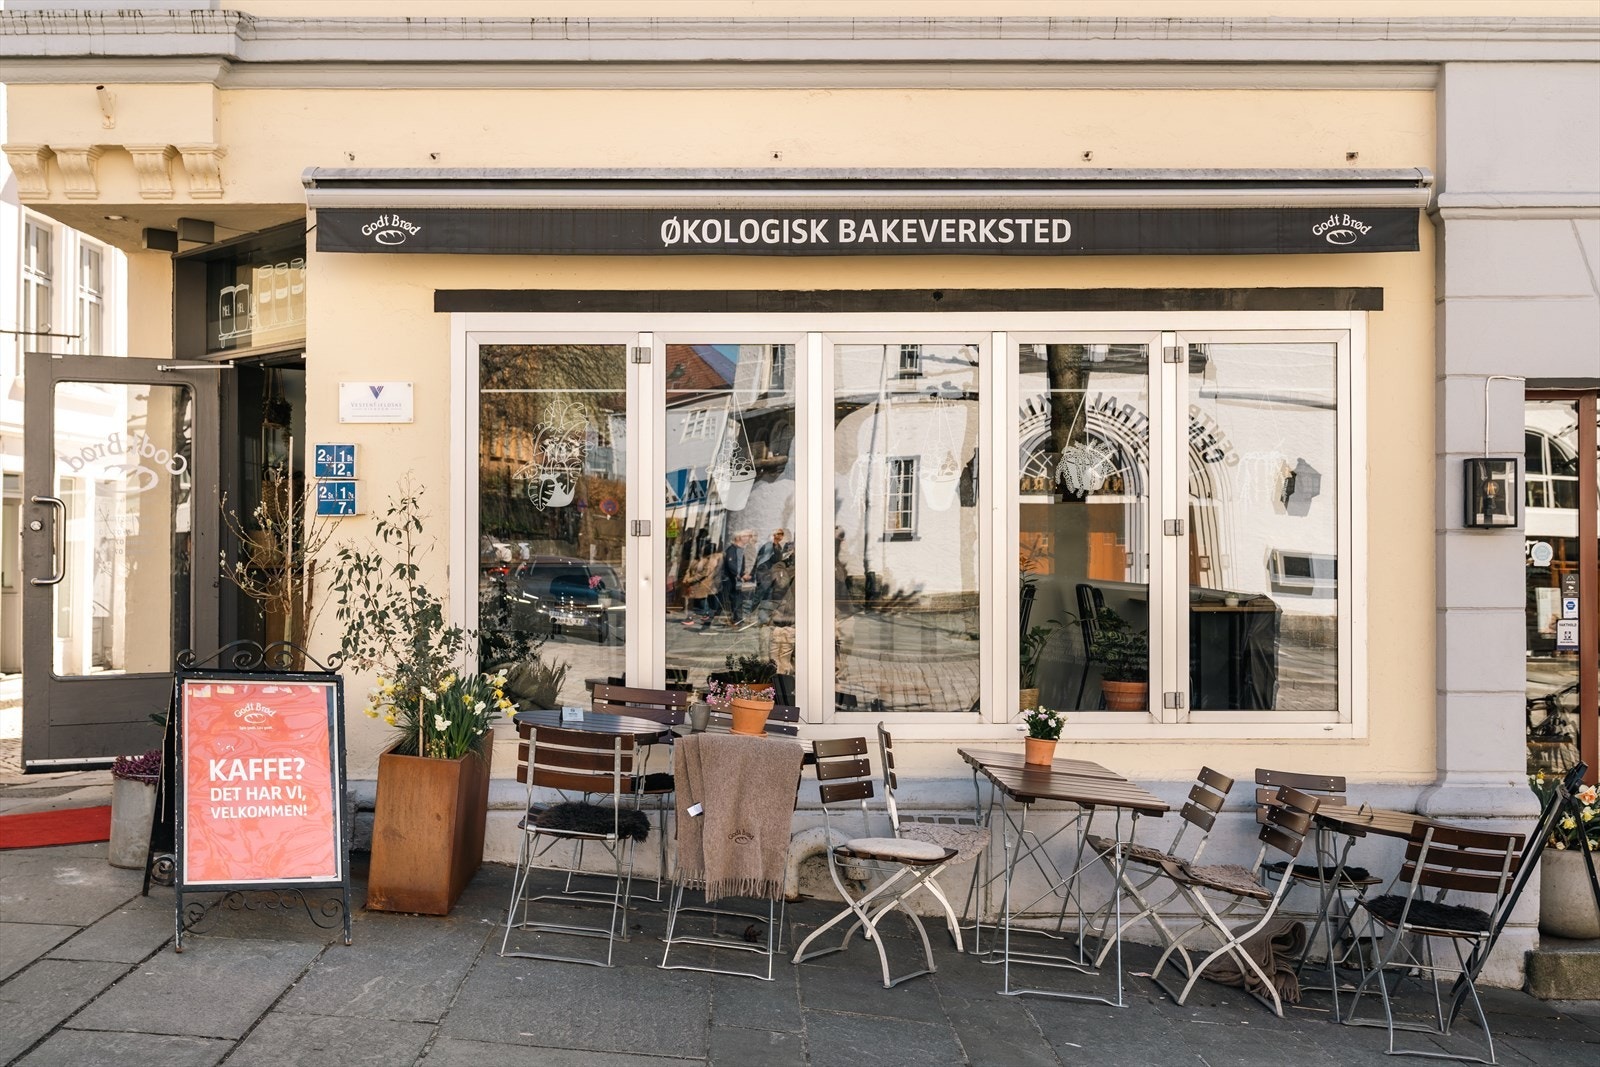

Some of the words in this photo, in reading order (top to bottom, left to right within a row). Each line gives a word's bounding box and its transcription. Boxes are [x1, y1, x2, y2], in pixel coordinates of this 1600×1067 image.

[361, 214, 389, 236] Godt
[391, 214, 421, 236] Brød
[660, 216, 829, 247] ØKOLOGISK
[838, 218, 1072, 244] BAKEVERKSTED
[1312, 213, 1340, 236] Godt
[1342, 213, 1372, 235] Brød
[222, 304, 231, 317] MEL
[317, 449, 327, 462] 2
[339, 450, 346, 462] 1
[332, 463, 346, 475] 12
[319, 486, 328, 499] 2
[340, 487, 346, 499] 1
[338, 501, 347, 514] 7
[234, 702, 253, 718] Godt
[256, 702, 277, 717] Brød
[209, 757, 306, 782] KAFFE?
[210, 787, 242, 802] DET
[246, 786, 283, 801] HAR
[285, 785, 307, 802] VI,
[210, 804, 308, 819] VELKOMMEN!
